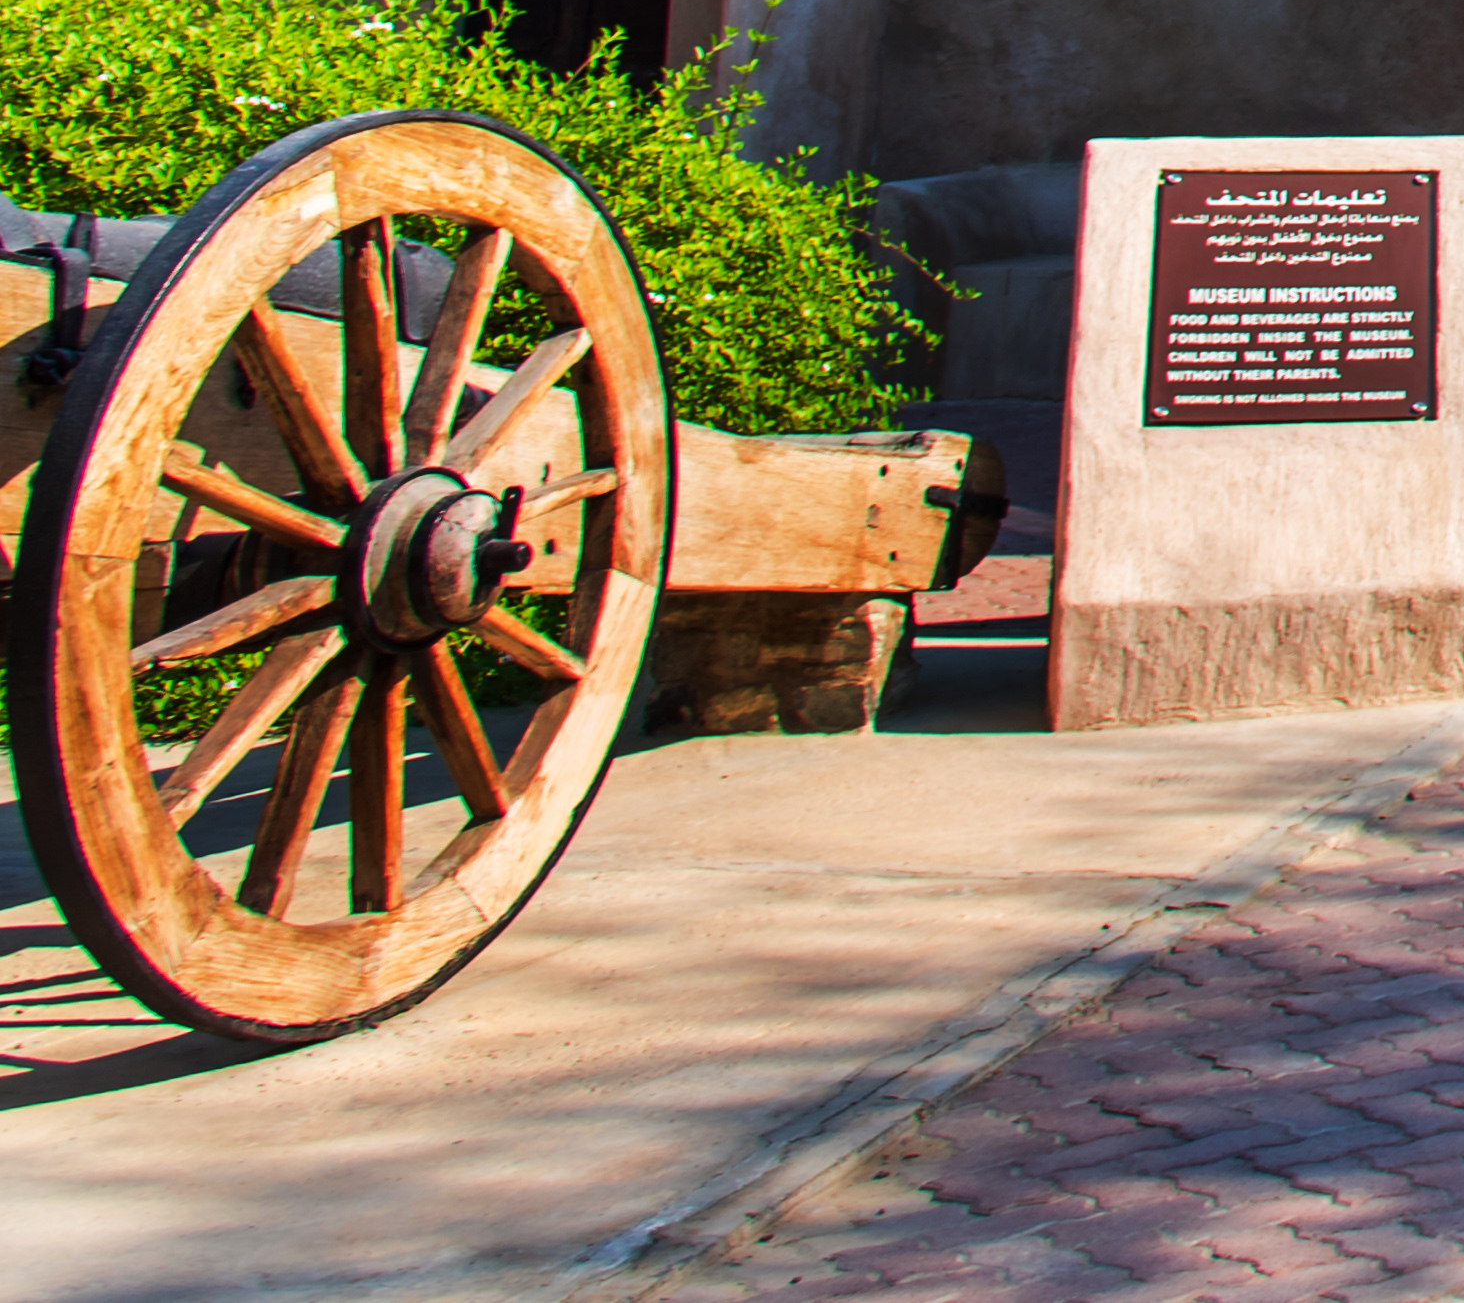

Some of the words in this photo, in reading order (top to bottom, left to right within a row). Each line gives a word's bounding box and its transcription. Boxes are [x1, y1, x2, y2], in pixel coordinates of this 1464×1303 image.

[1204, 188, 1288, 207] المتحف
[1292, 189, 1387, 211] تعليمات
[1169, 213, 1210, 225] المتحف
[1208, 214, 1238, 228] داخل
[1310, 231, 1343, 247] دخول
[1341, 232, 1385, 247] ممنوع
[1213, 251, 1257, 264] المتحف
[1255, 251, 1287, 267] داخل
[1285, 251, 1332, 266] التدخين
[1330, 251, 1373, 267] ممنوع
[1187, 287, 1266, 305] MUSEUM
[1267, 285, 1397, 304] INSTRUCTIONS
[1169, 314, 1208, 327] FOOD
[1209, 313, 1239, 326] AND
[1240, 312, 1320, 326] BEVERAGES
[1321, 312, 1350, 325] ARE
[1350, 310, 1414, 324] STRICTLY
[1168, 332, 1250, 345] FORBIDDEN
[1257, 331, 1306, 344] INSIDE
[1313, 330, 1343, 343] THE
[1348, 329, 1414, 343] MUSEUM.
[1167, 350, 1237, 364] CHILDREN
[1243, 350, 1277, 363] WILL
[1283, 349, 1314, 362] NOT
[1319, 349, 1340, 362] BE
[1346, 347, 1414, 361] ADMITTED
[1166, 369, 1231, 382] WITHOUT
[1233, 369, 1275, 381] THEIR
[1276, 367, 1341, 381] PARENTS.
